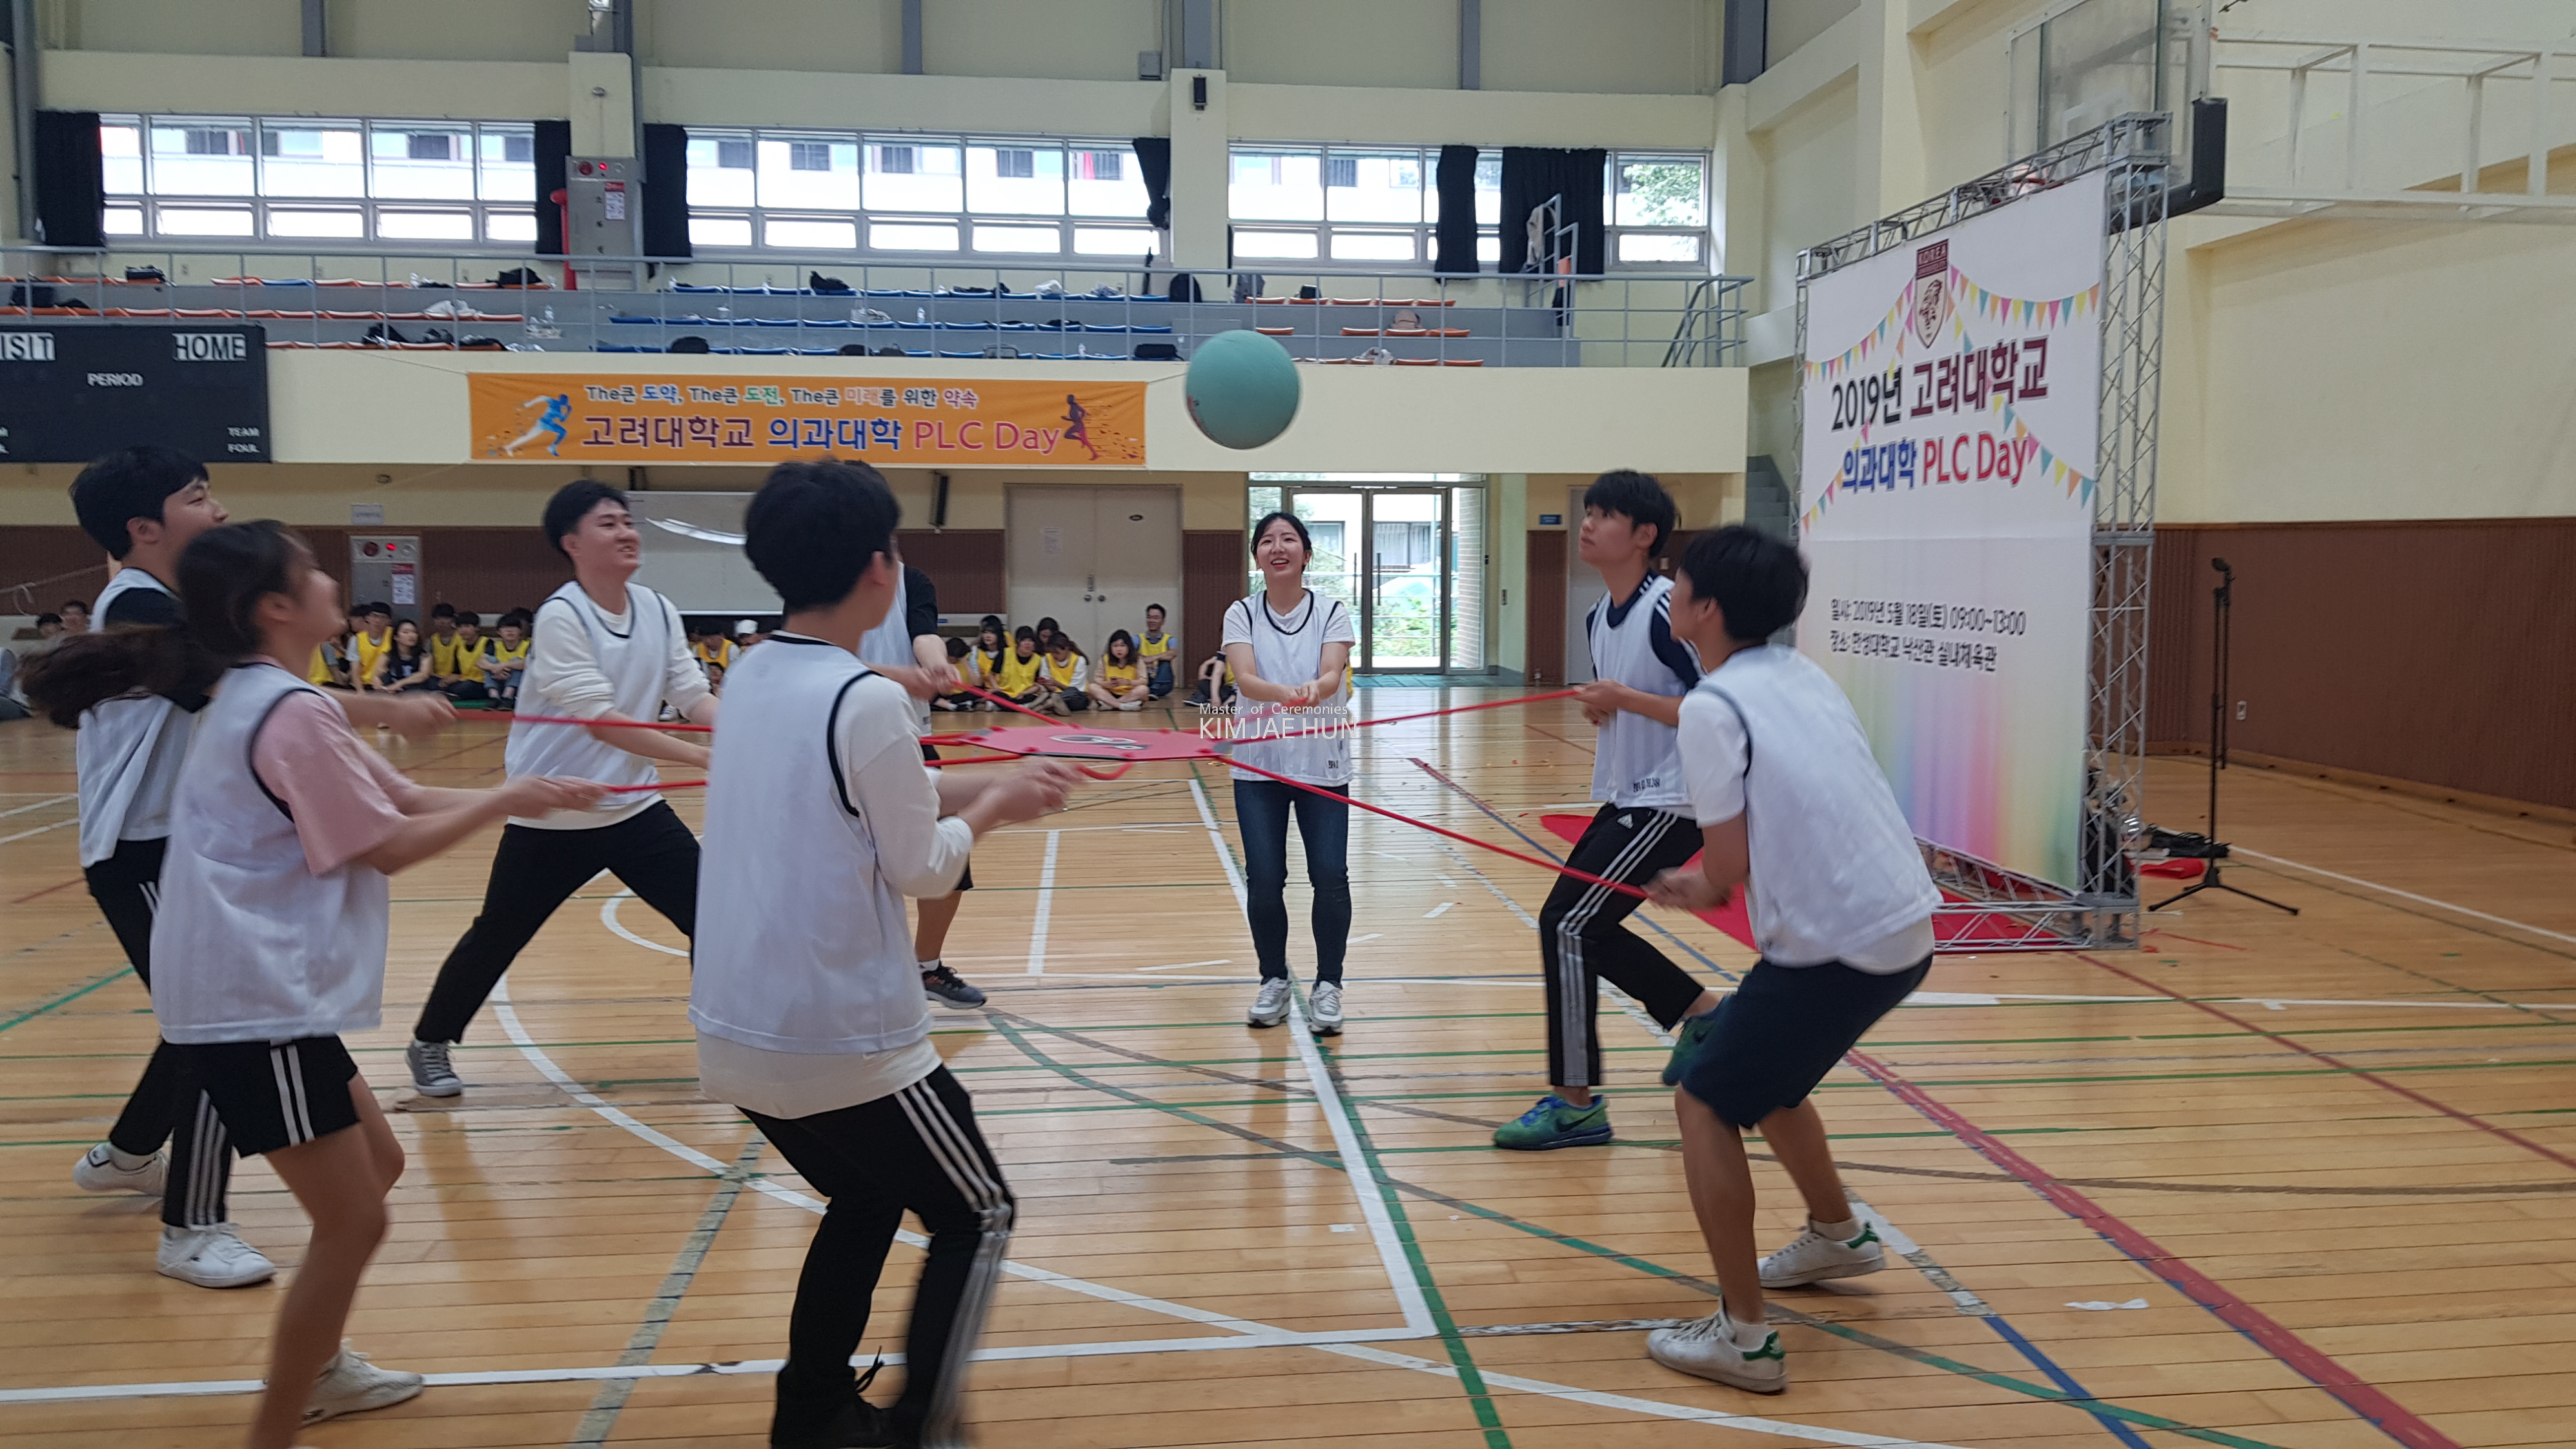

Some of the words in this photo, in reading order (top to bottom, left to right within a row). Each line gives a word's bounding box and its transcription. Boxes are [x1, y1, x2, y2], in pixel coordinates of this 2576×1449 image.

[174, 334, 247, 361] HOME
[87, 372, 143, 387] PERIOD
[1832, 367, 1902, 431] 2019년
[1909, 336, 2049, 417] 고려대학교
[586, 387, 636, 403] The큰
[642, 385, 683, 403] 도약,
[689, 387, 738, 404] The큰
[744, 387, 785, 405] 도전,
[791, 389, 840, 405] The큰
[846, 389, 897, 407] 미래를
[904, 389, 938, 407] 위한
[944, 389, 978, 408] 약속
[227, 427, 259, 436] TEAM
[583, 415, 754, 449] 고려대학교
[767, 418, 903, 450] 의과대학
[913, 420, 984, 449] PLC
[995, 421, 1062, 454] Day
[227, 443, 260, 453] FOUL
[1842, 437, 1917, 493] 의과대학
[1922, 434, 1971, 485] PLC
[1977, 431, 2027, 487] Day
[1852, 600, 1885, 623] 2019년
[1887, 602, 1903, 625] 5월
[1938, 642, 1998, 672] 실내체육관
